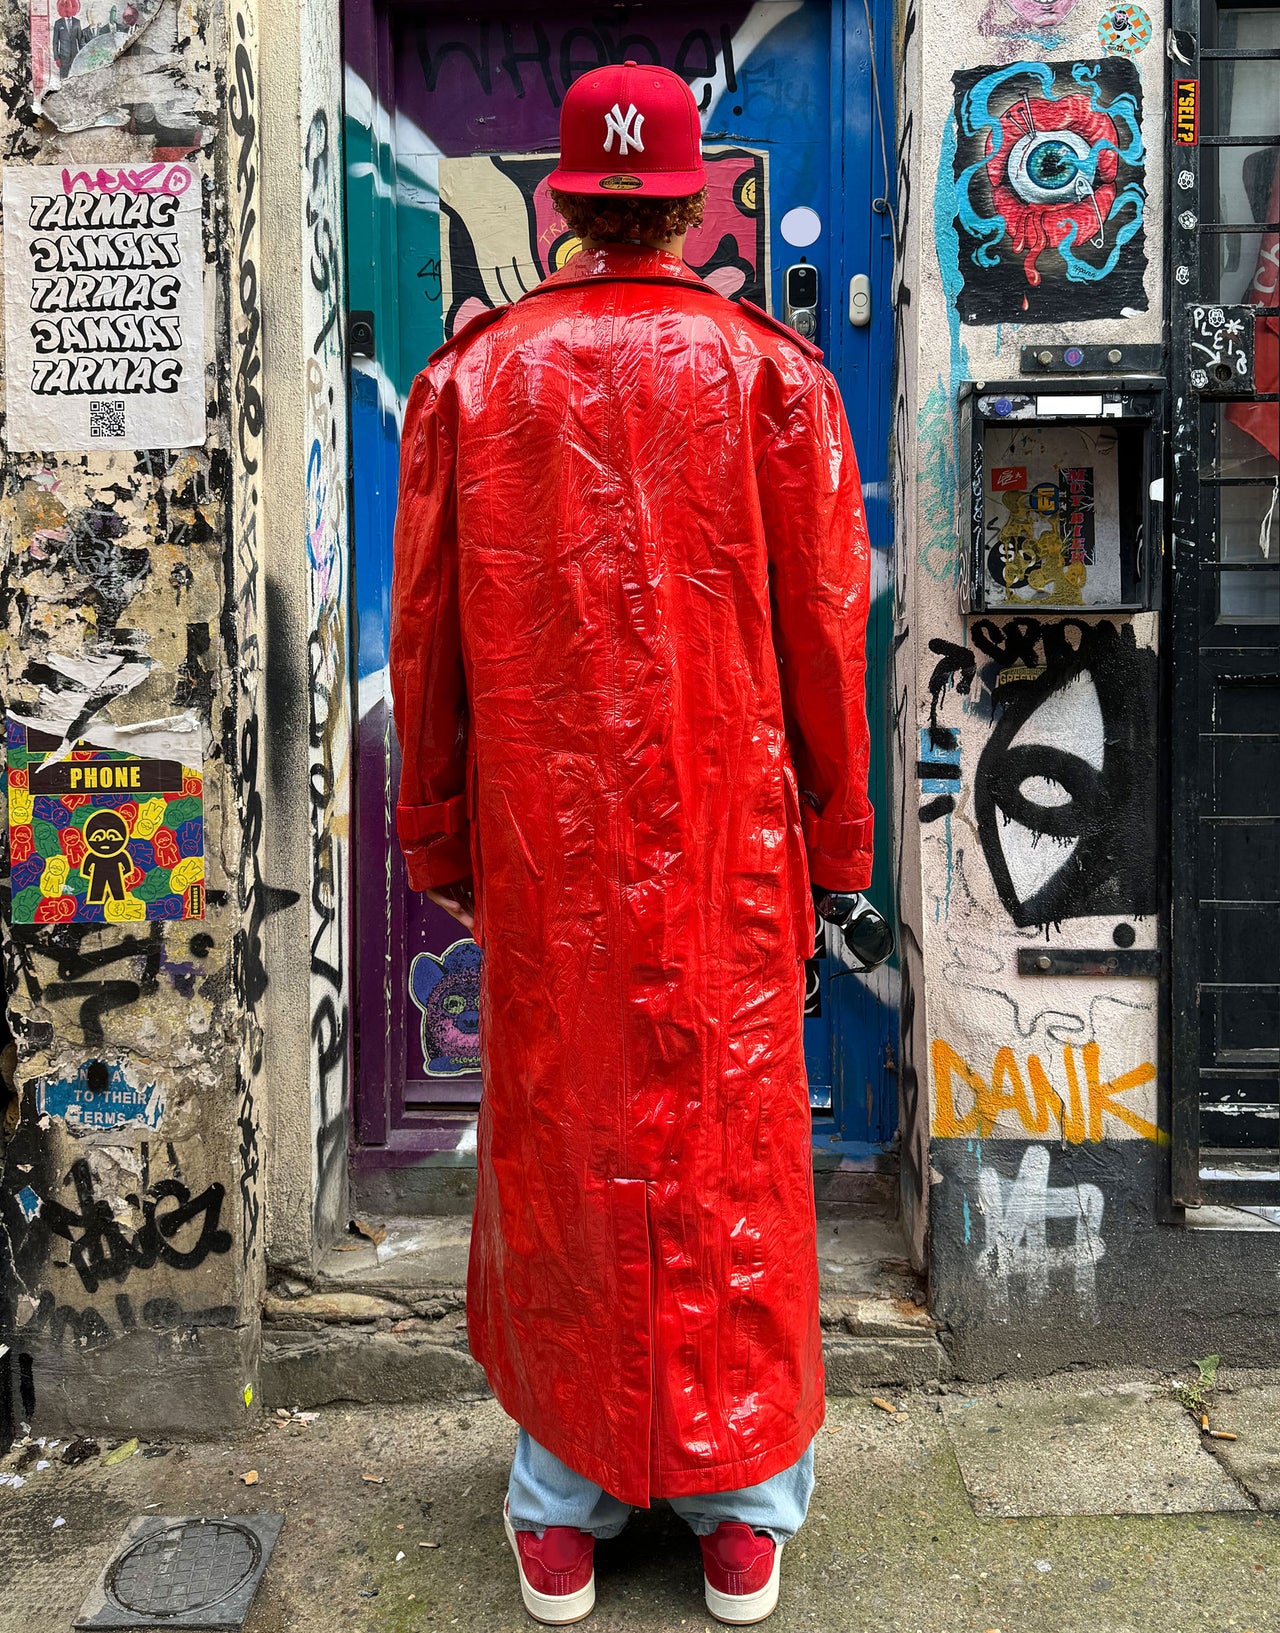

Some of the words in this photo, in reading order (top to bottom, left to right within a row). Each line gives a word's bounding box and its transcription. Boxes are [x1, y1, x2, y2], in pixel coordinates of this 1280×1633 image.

[603, 103, 645, 155] NY
[1178, 82, 1195, 142] Y'SELF?
[29, 192, 181, 231] TARMAC
[30, 274, 182, 312] TARMAC
[31, 356, 184, 395] TARMAC
[70, 766, 141, 789] PHONE
[74, 1089, 95, 1102] TO
[102, 1091, 147, 1105] THEIR
[931, 1038, 1171, 1146] DANK
